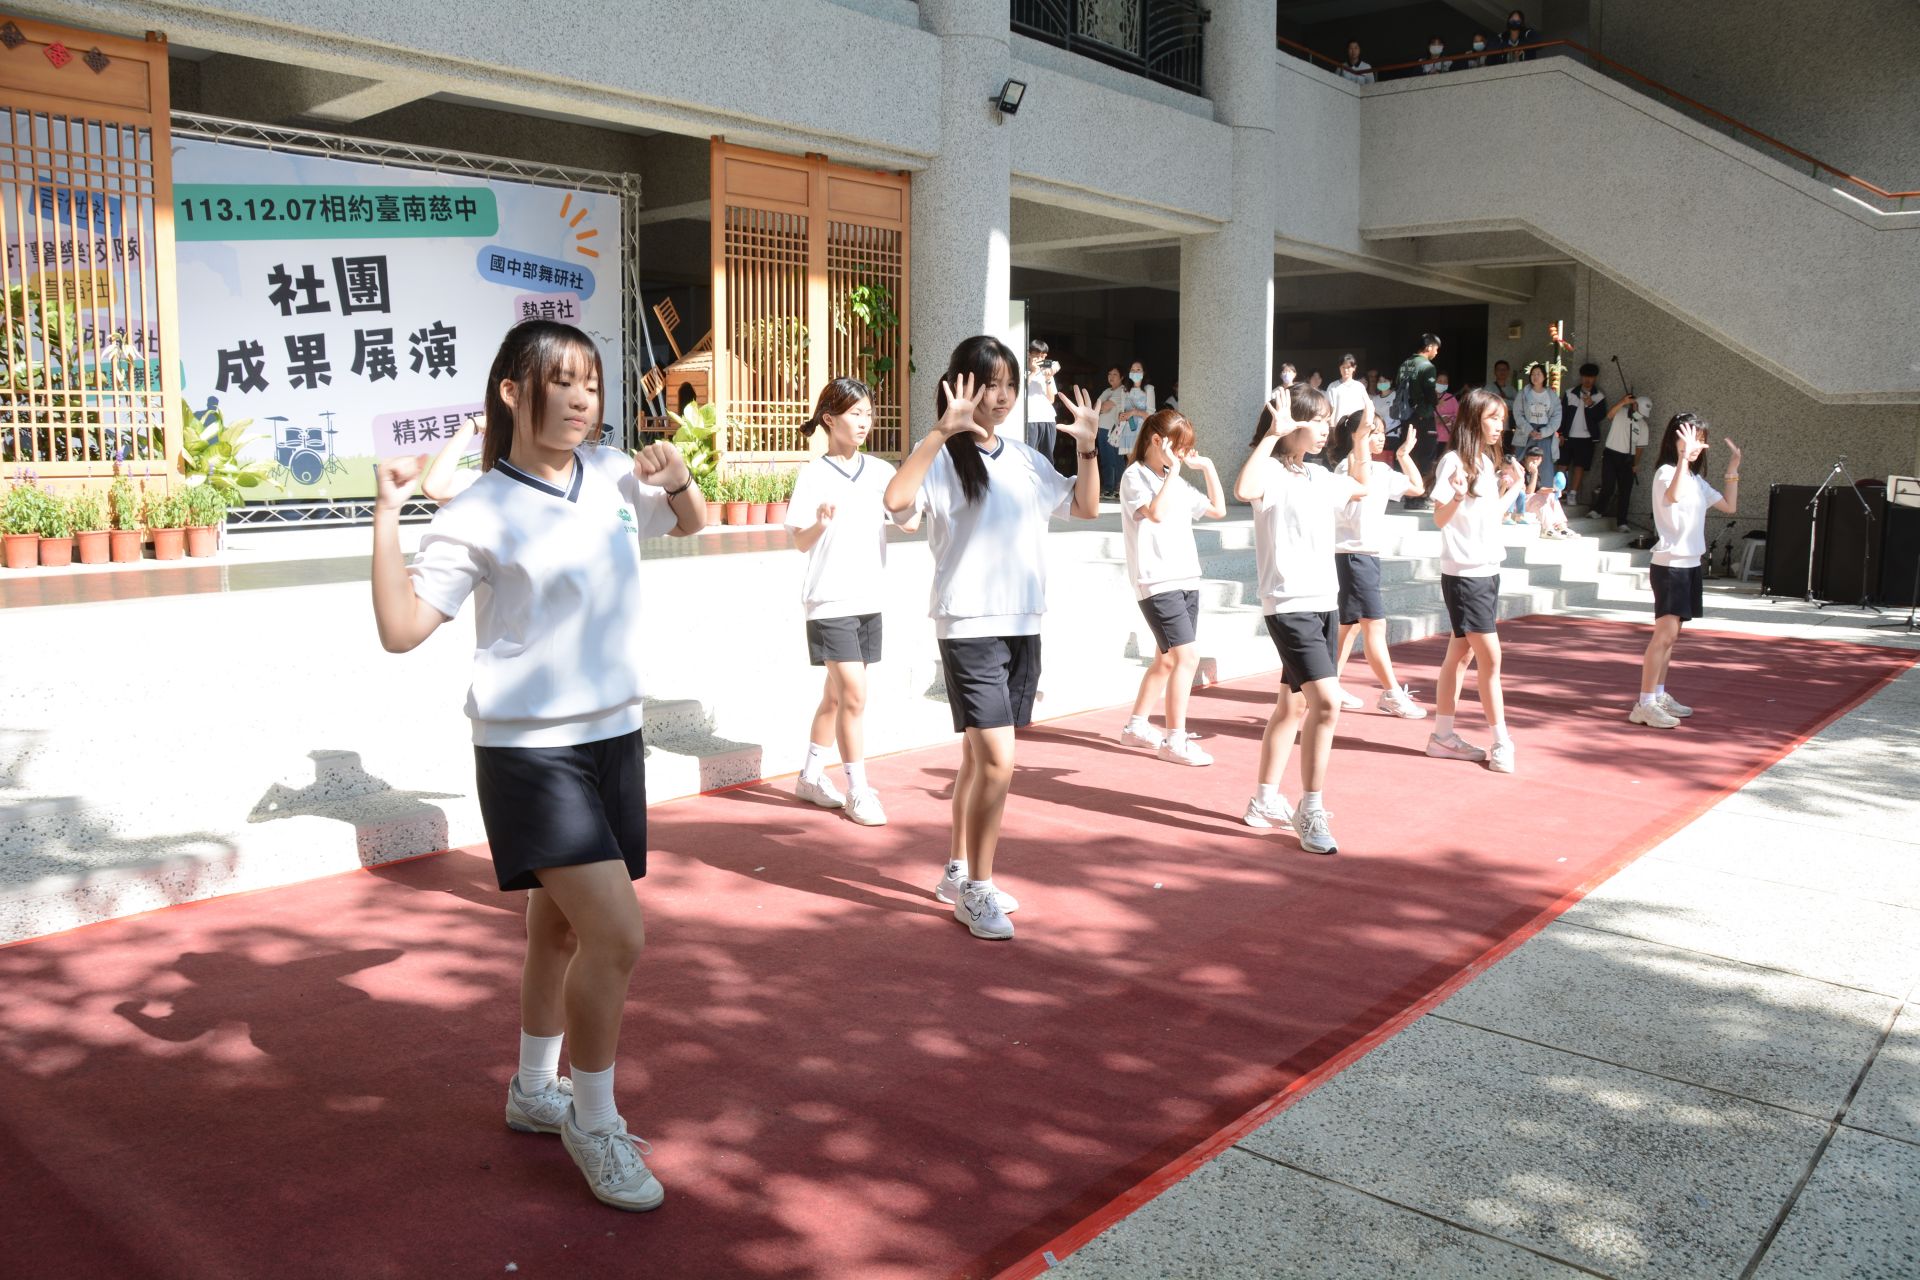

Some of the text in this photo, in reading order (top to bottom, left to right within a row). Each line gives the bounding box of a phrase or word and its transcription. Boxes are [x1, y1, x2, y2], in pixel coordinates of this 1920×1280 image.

[181, 194, 477, 223] 113.12.07相約臺南慈中
[267, 255, 391, 316] 社團
[490, 253, 584, 290] 國中部舞研社
[215, 320, 459, 394] 成果展演
[392, 411, 484, 445] 精采呈
